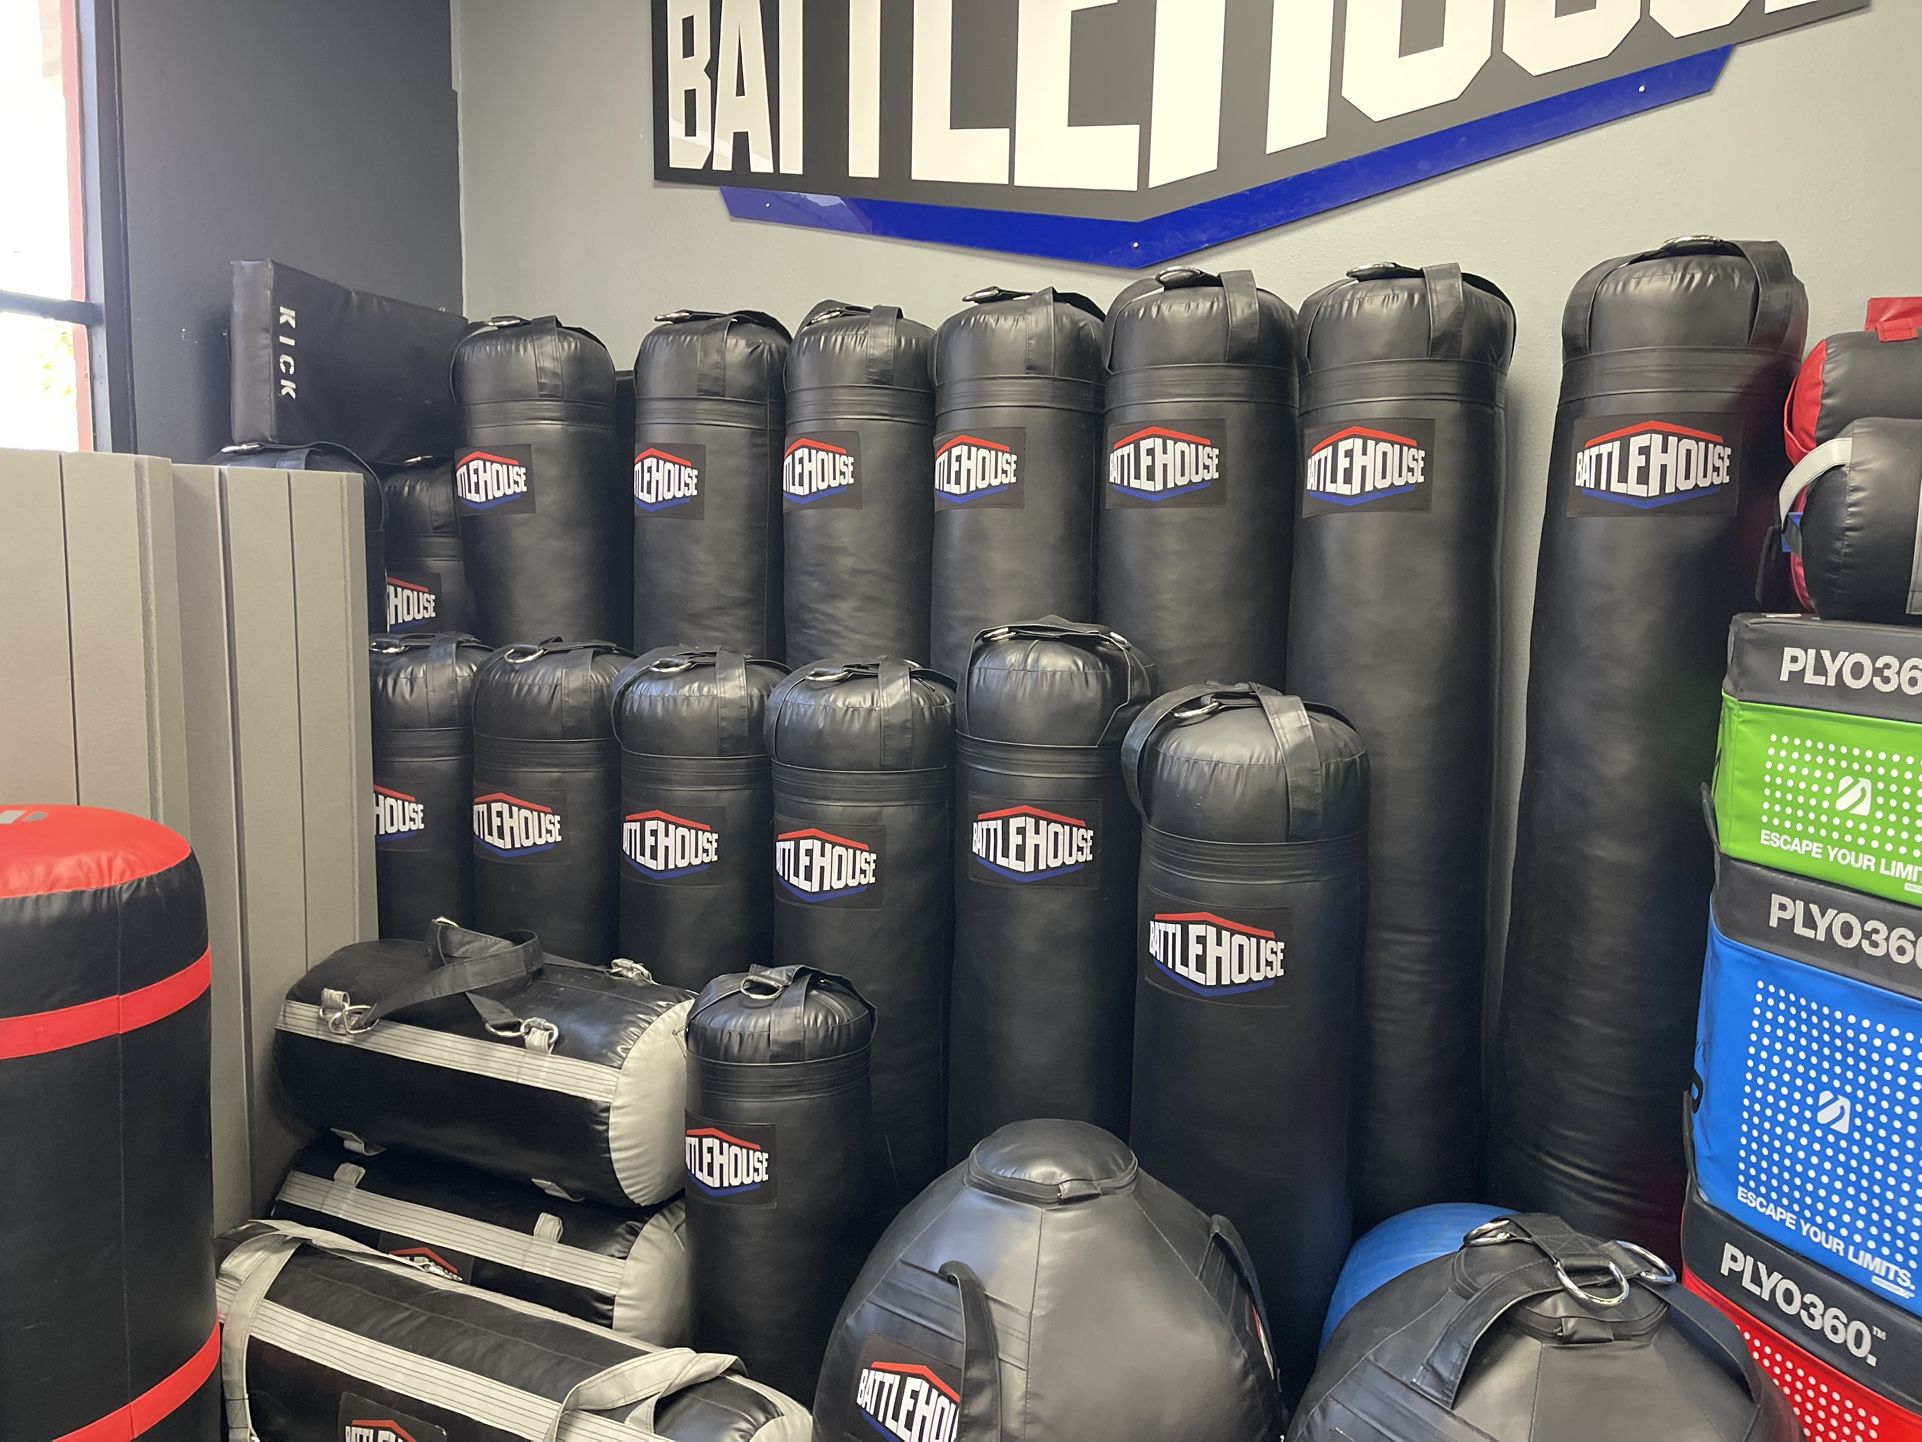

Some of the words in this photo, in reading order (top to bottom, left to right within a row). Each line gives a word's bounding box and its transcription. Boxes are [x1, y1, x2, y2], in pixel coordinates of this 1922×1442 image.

[279, 306, 296, 400] KICK
[1575, 433, 1731, 497] BATTLEHOUSE
[972, 816, 1094, 873] BATTLEHOUSE
[1760, 829, 1824, 859] ESCAPE
[1827, 845, 1876, 872] YOUR
[1149, 920, 1285, 986] BATTLEHOUSE
[1768, 893, 1922, 970] PLYO36
[1737, 1186, 1797, 1231] ESCAPE
[1799, 1219, 1846, 1257] YOUR
[1847, 1245, 1916, 1291] LIMITS.
